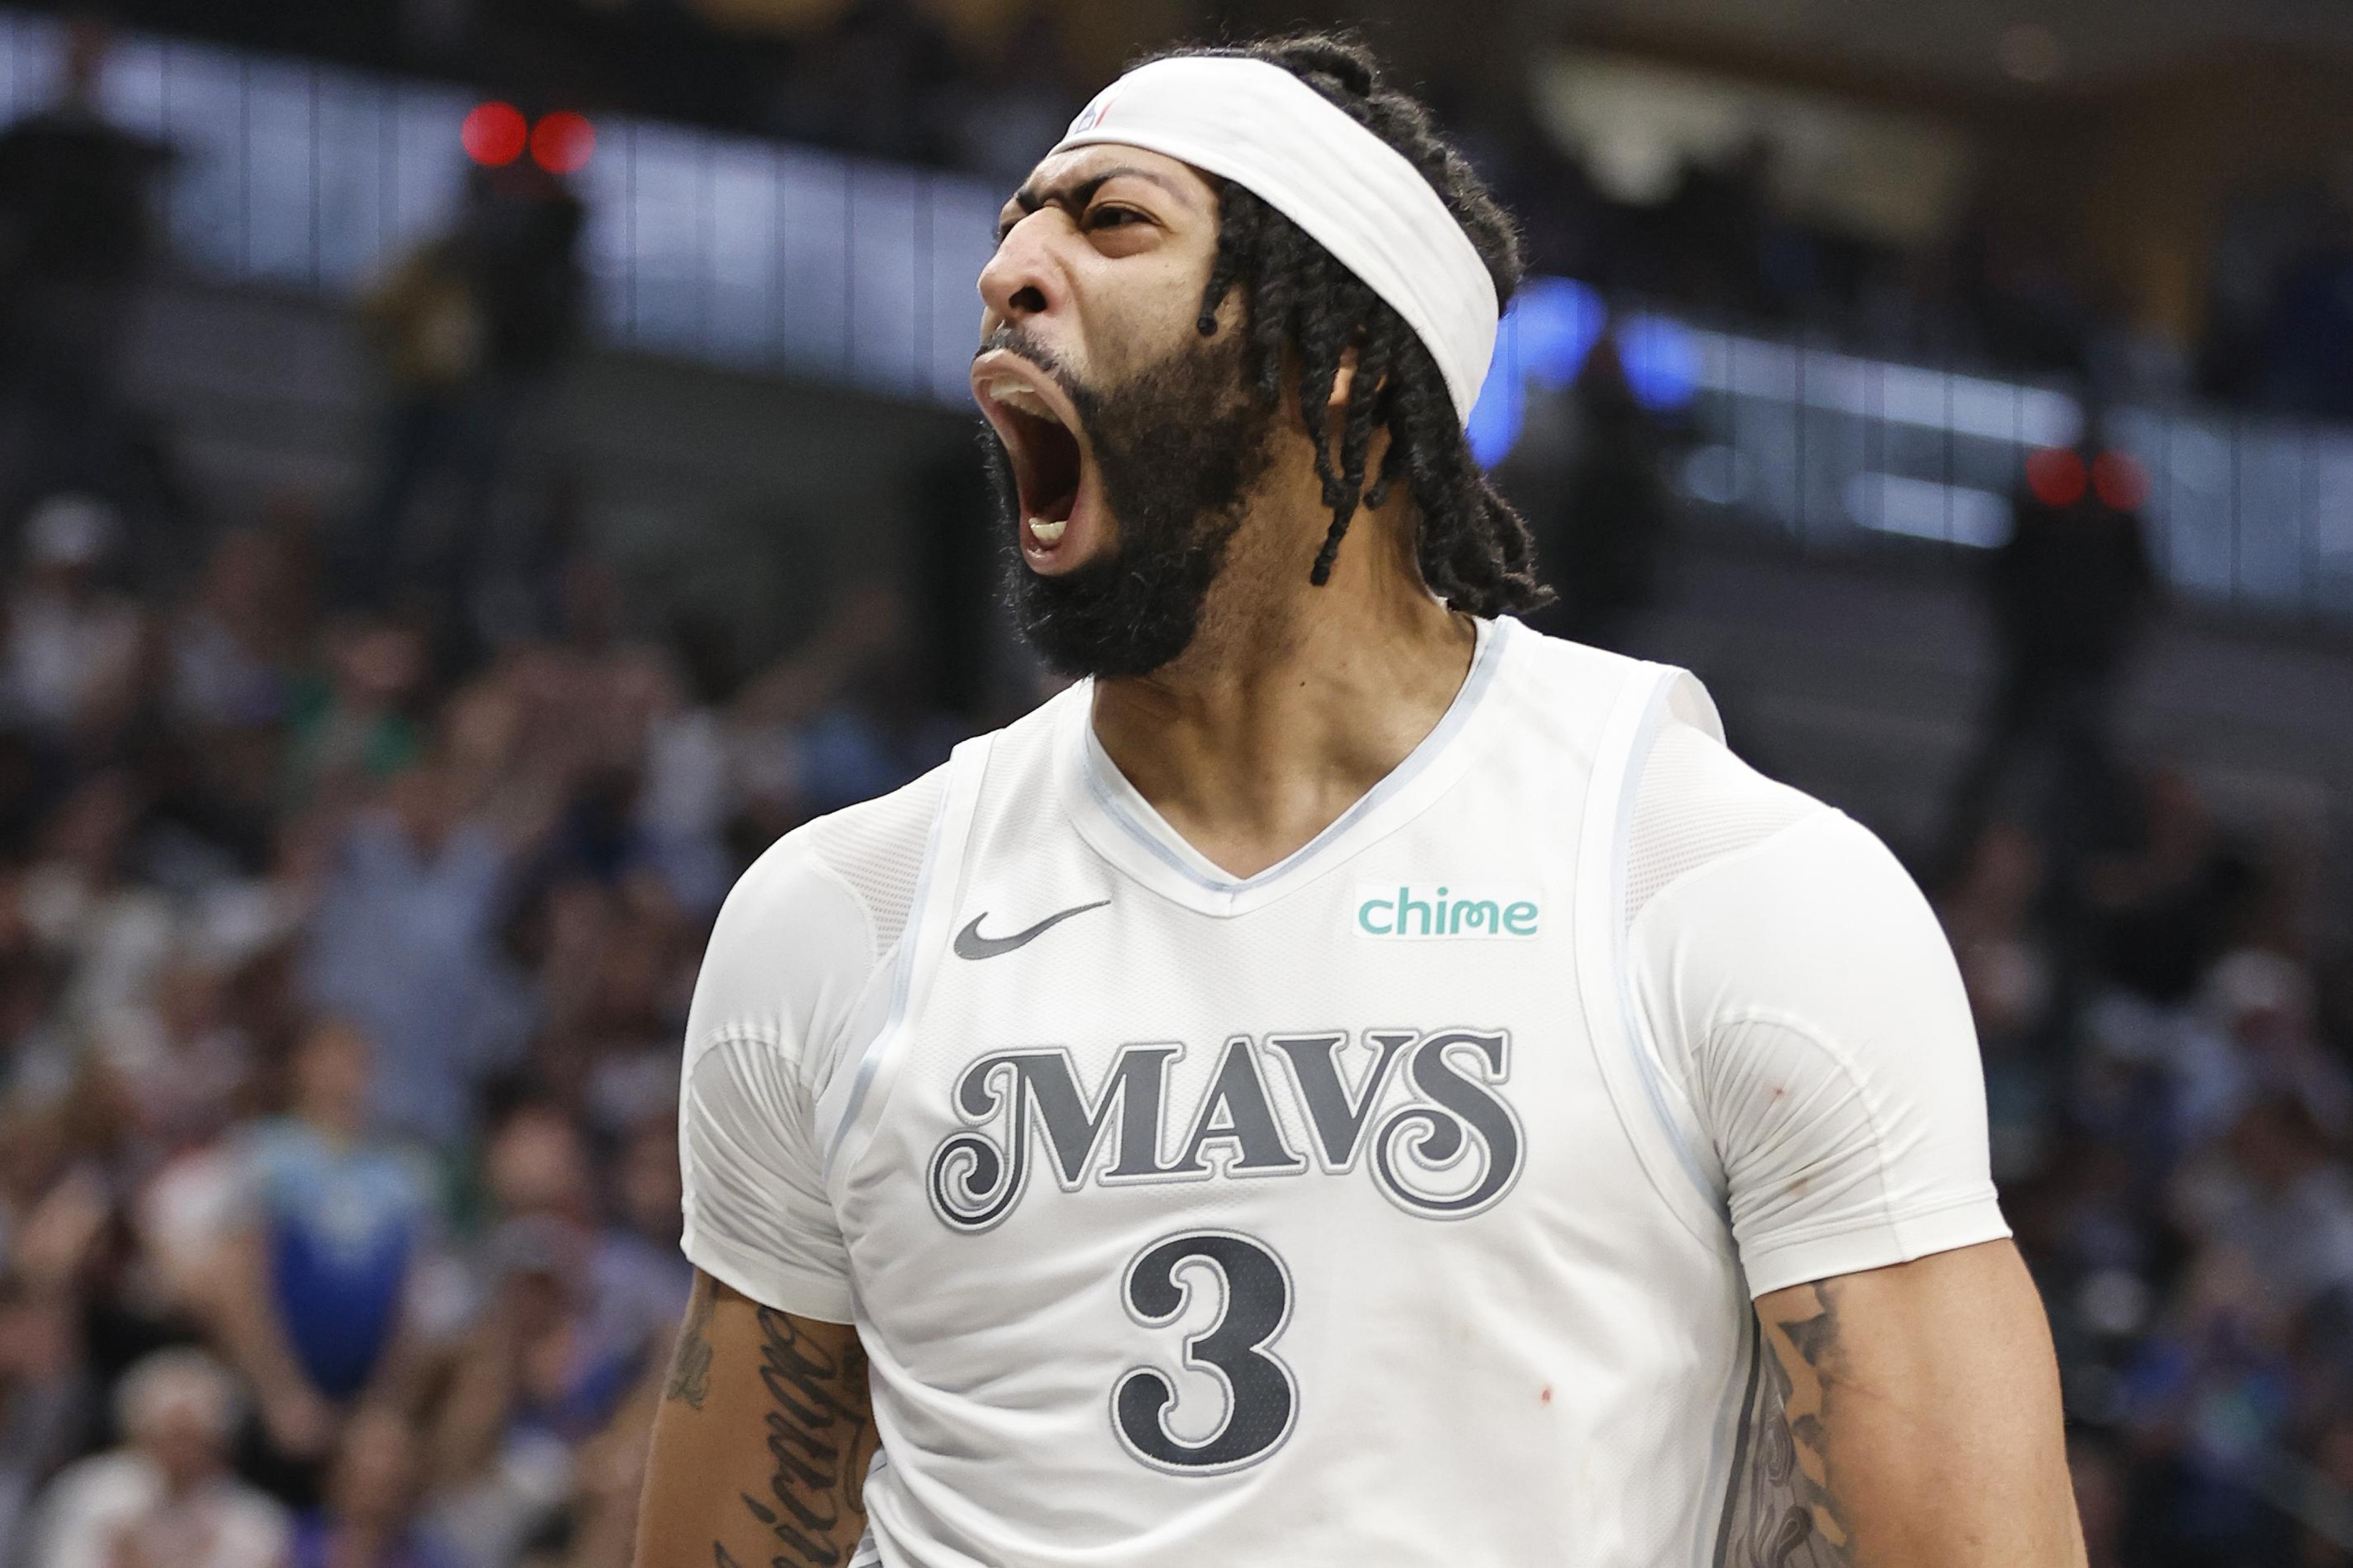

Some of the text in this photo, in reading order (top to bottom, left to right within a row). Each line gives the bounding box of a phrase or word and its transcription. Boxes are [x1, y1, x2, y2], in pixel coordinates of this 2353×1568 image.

[1358, 886, 1539, 936] chime
[925, 1026, 1526, 1236] MAVS
[1108, 1227, 1301, 1477] 3
